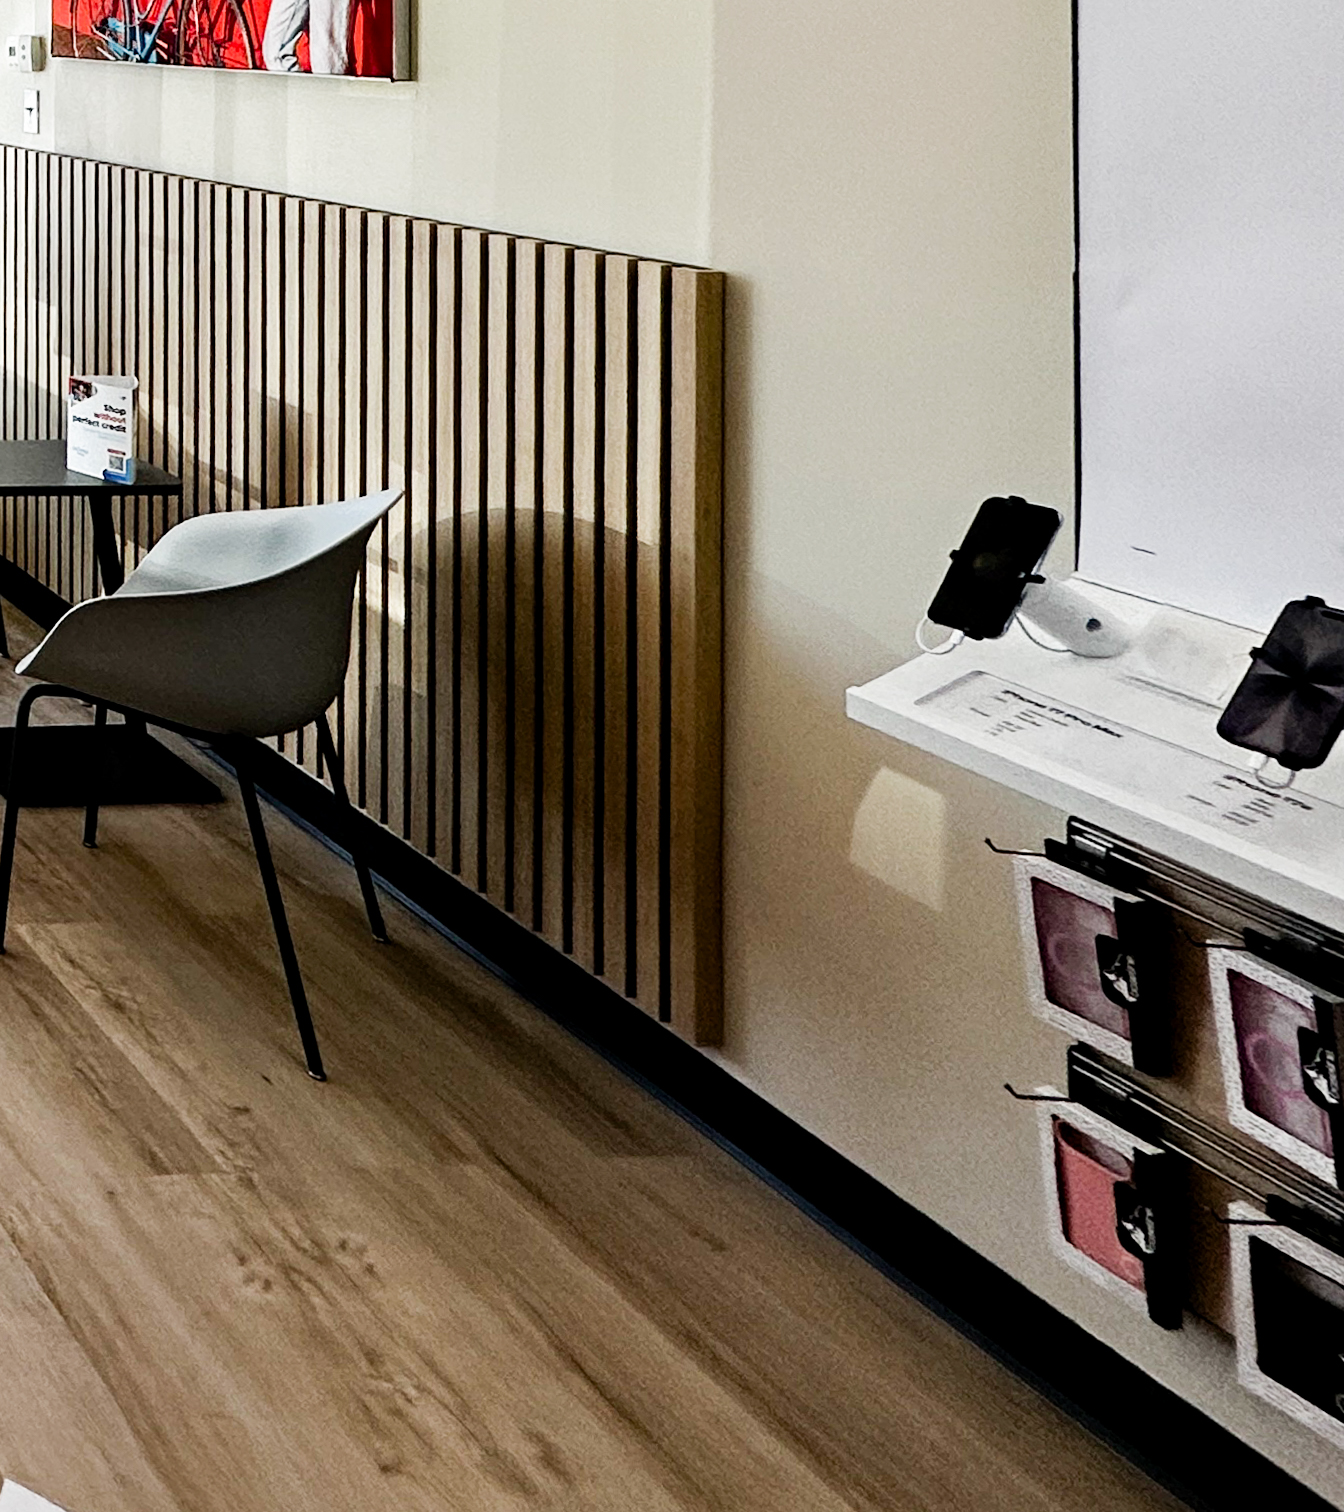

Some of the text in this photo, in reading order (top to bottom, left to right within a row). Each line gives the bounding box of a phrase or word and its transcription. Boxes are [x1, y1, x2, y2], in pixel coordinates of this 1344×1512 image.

[72, 415, 126, 433] perfect credit
[94, 413, 126, 424] without
